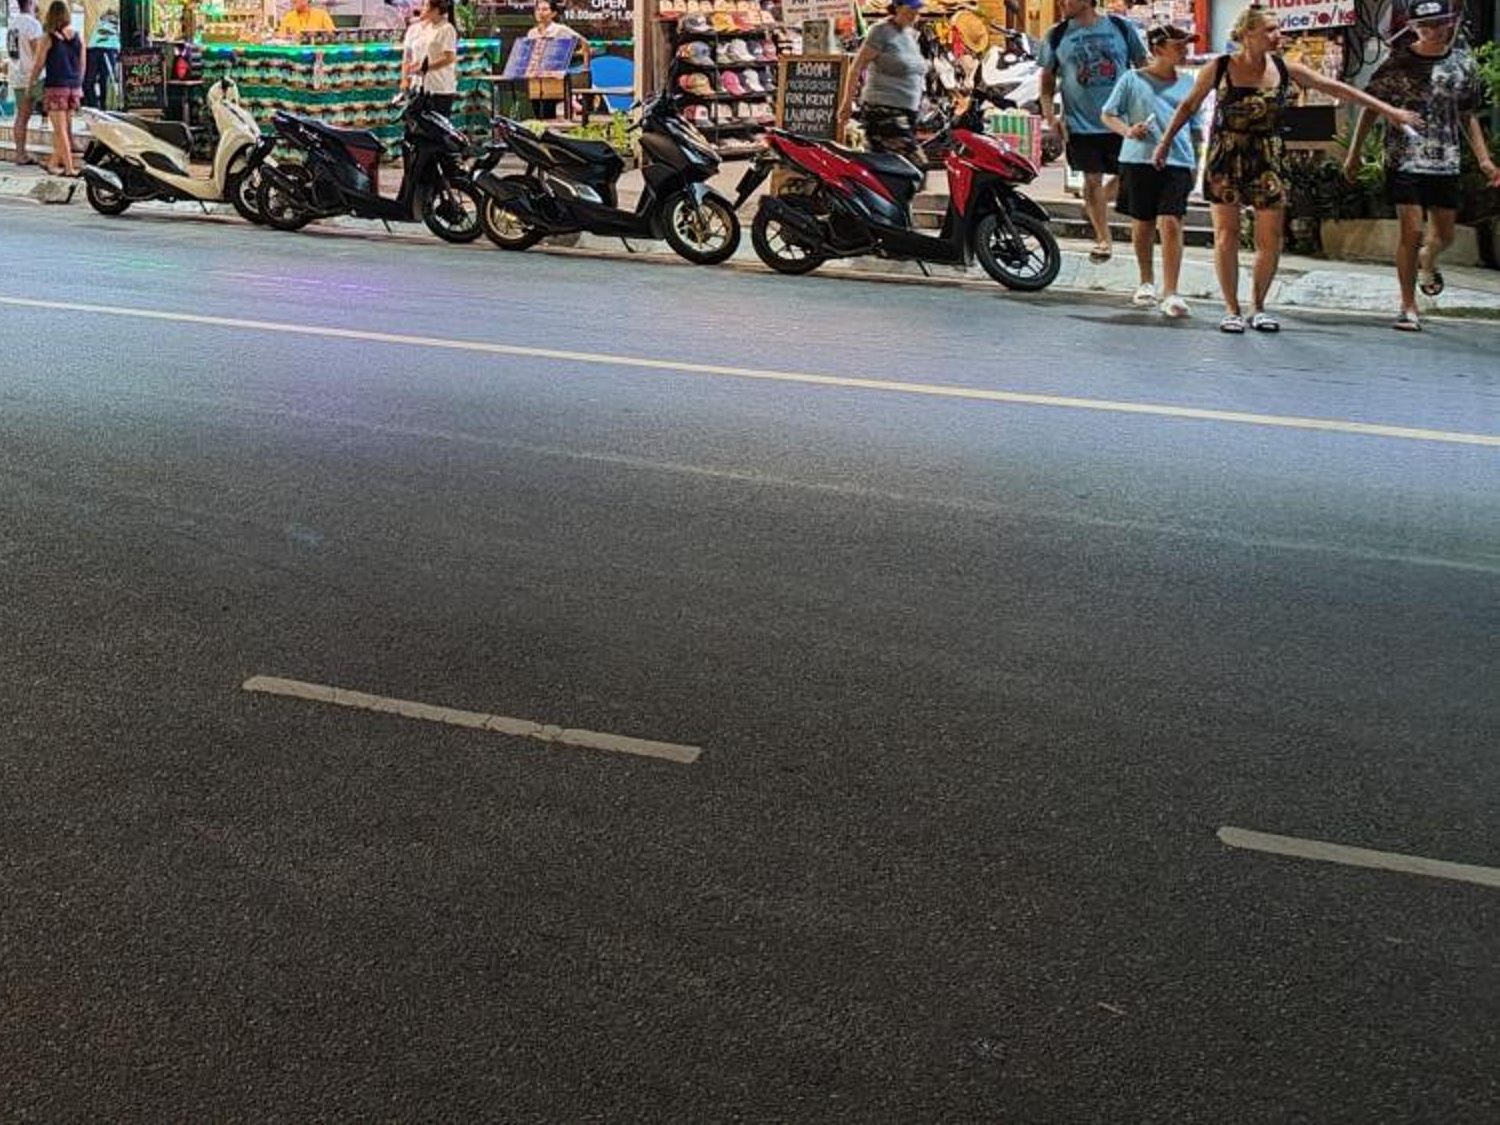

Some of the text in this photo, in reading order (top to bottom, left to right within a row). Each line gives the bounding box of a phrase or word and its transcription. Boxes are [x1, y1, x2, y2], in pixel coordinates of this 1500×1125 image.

[796, 62, 831, 77] ROOM
[785, 92, 835, 106] FOR RENT
